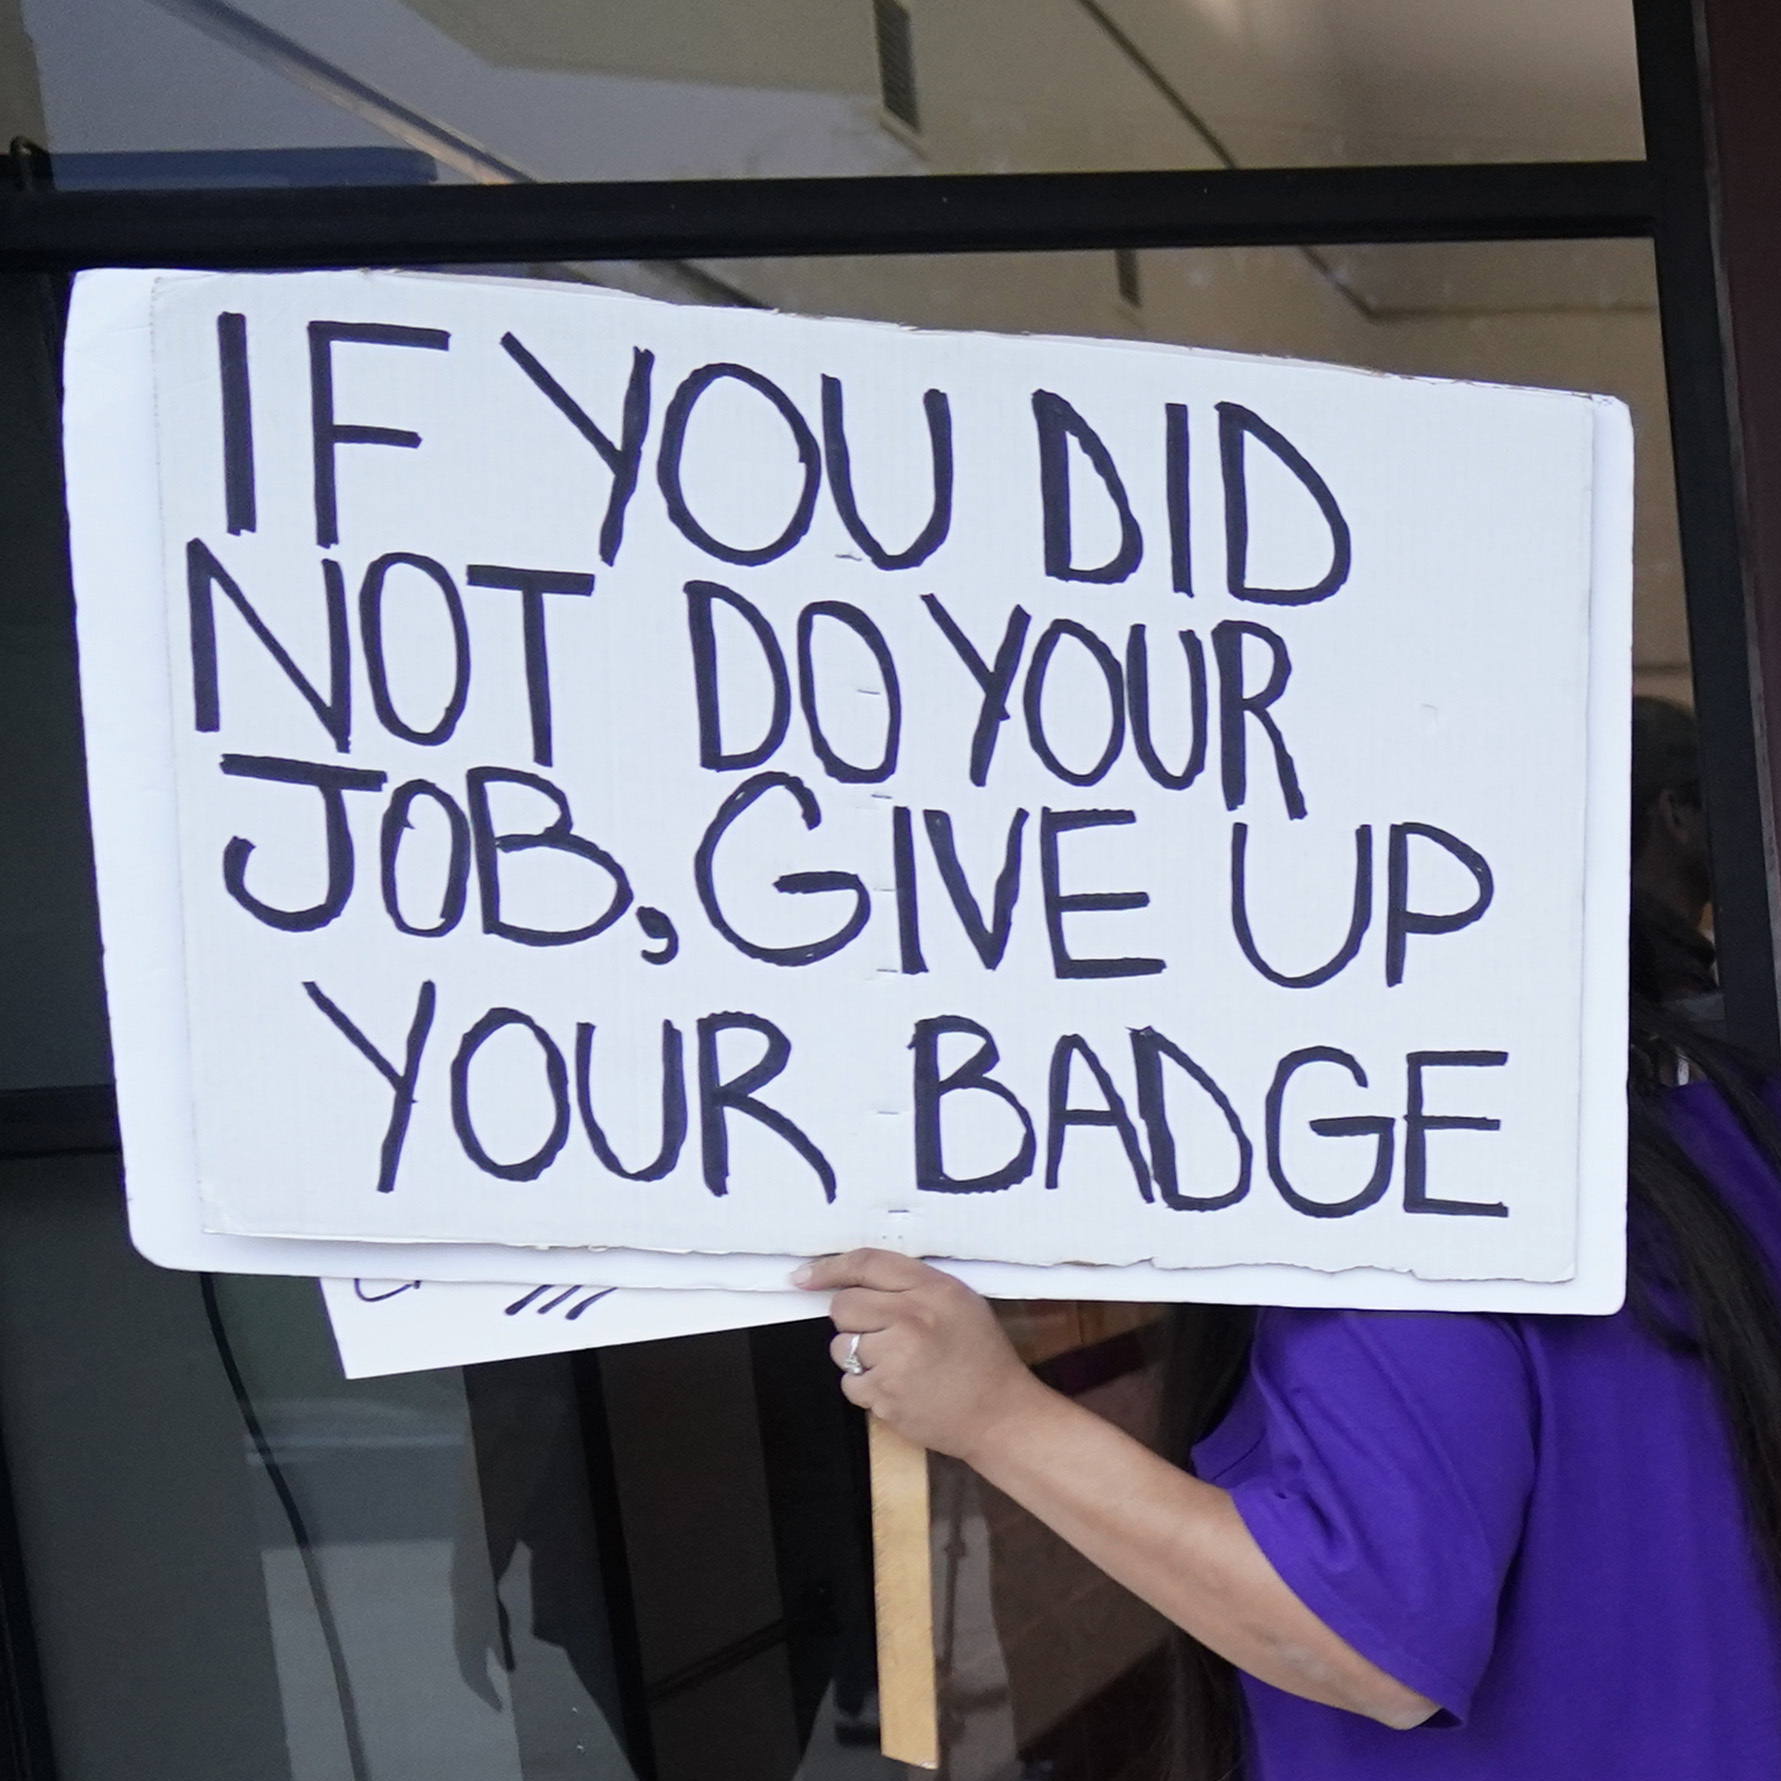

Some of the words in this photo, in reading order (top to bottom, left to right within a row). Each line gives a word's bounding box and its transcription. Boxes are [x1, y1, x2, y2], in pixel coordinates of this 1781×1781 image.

[218, 312, 452, 550] IF
[502, 332, 954, 572] YOU
[1032, 389, 1352, 608] DID
[187, 538, 596, 768] NOT
[684, 580, 902, 788] DO
[921, 594, 1308, 821] YOUR
[220, 754, 680, 966] JOB,
[695, 771, 1168, 980] GIVE
[1232, 822, 1495, 989] UP
[303, 981, 837, 1205] YOUR
[909, 1015, 1510, 1220] BADGE
